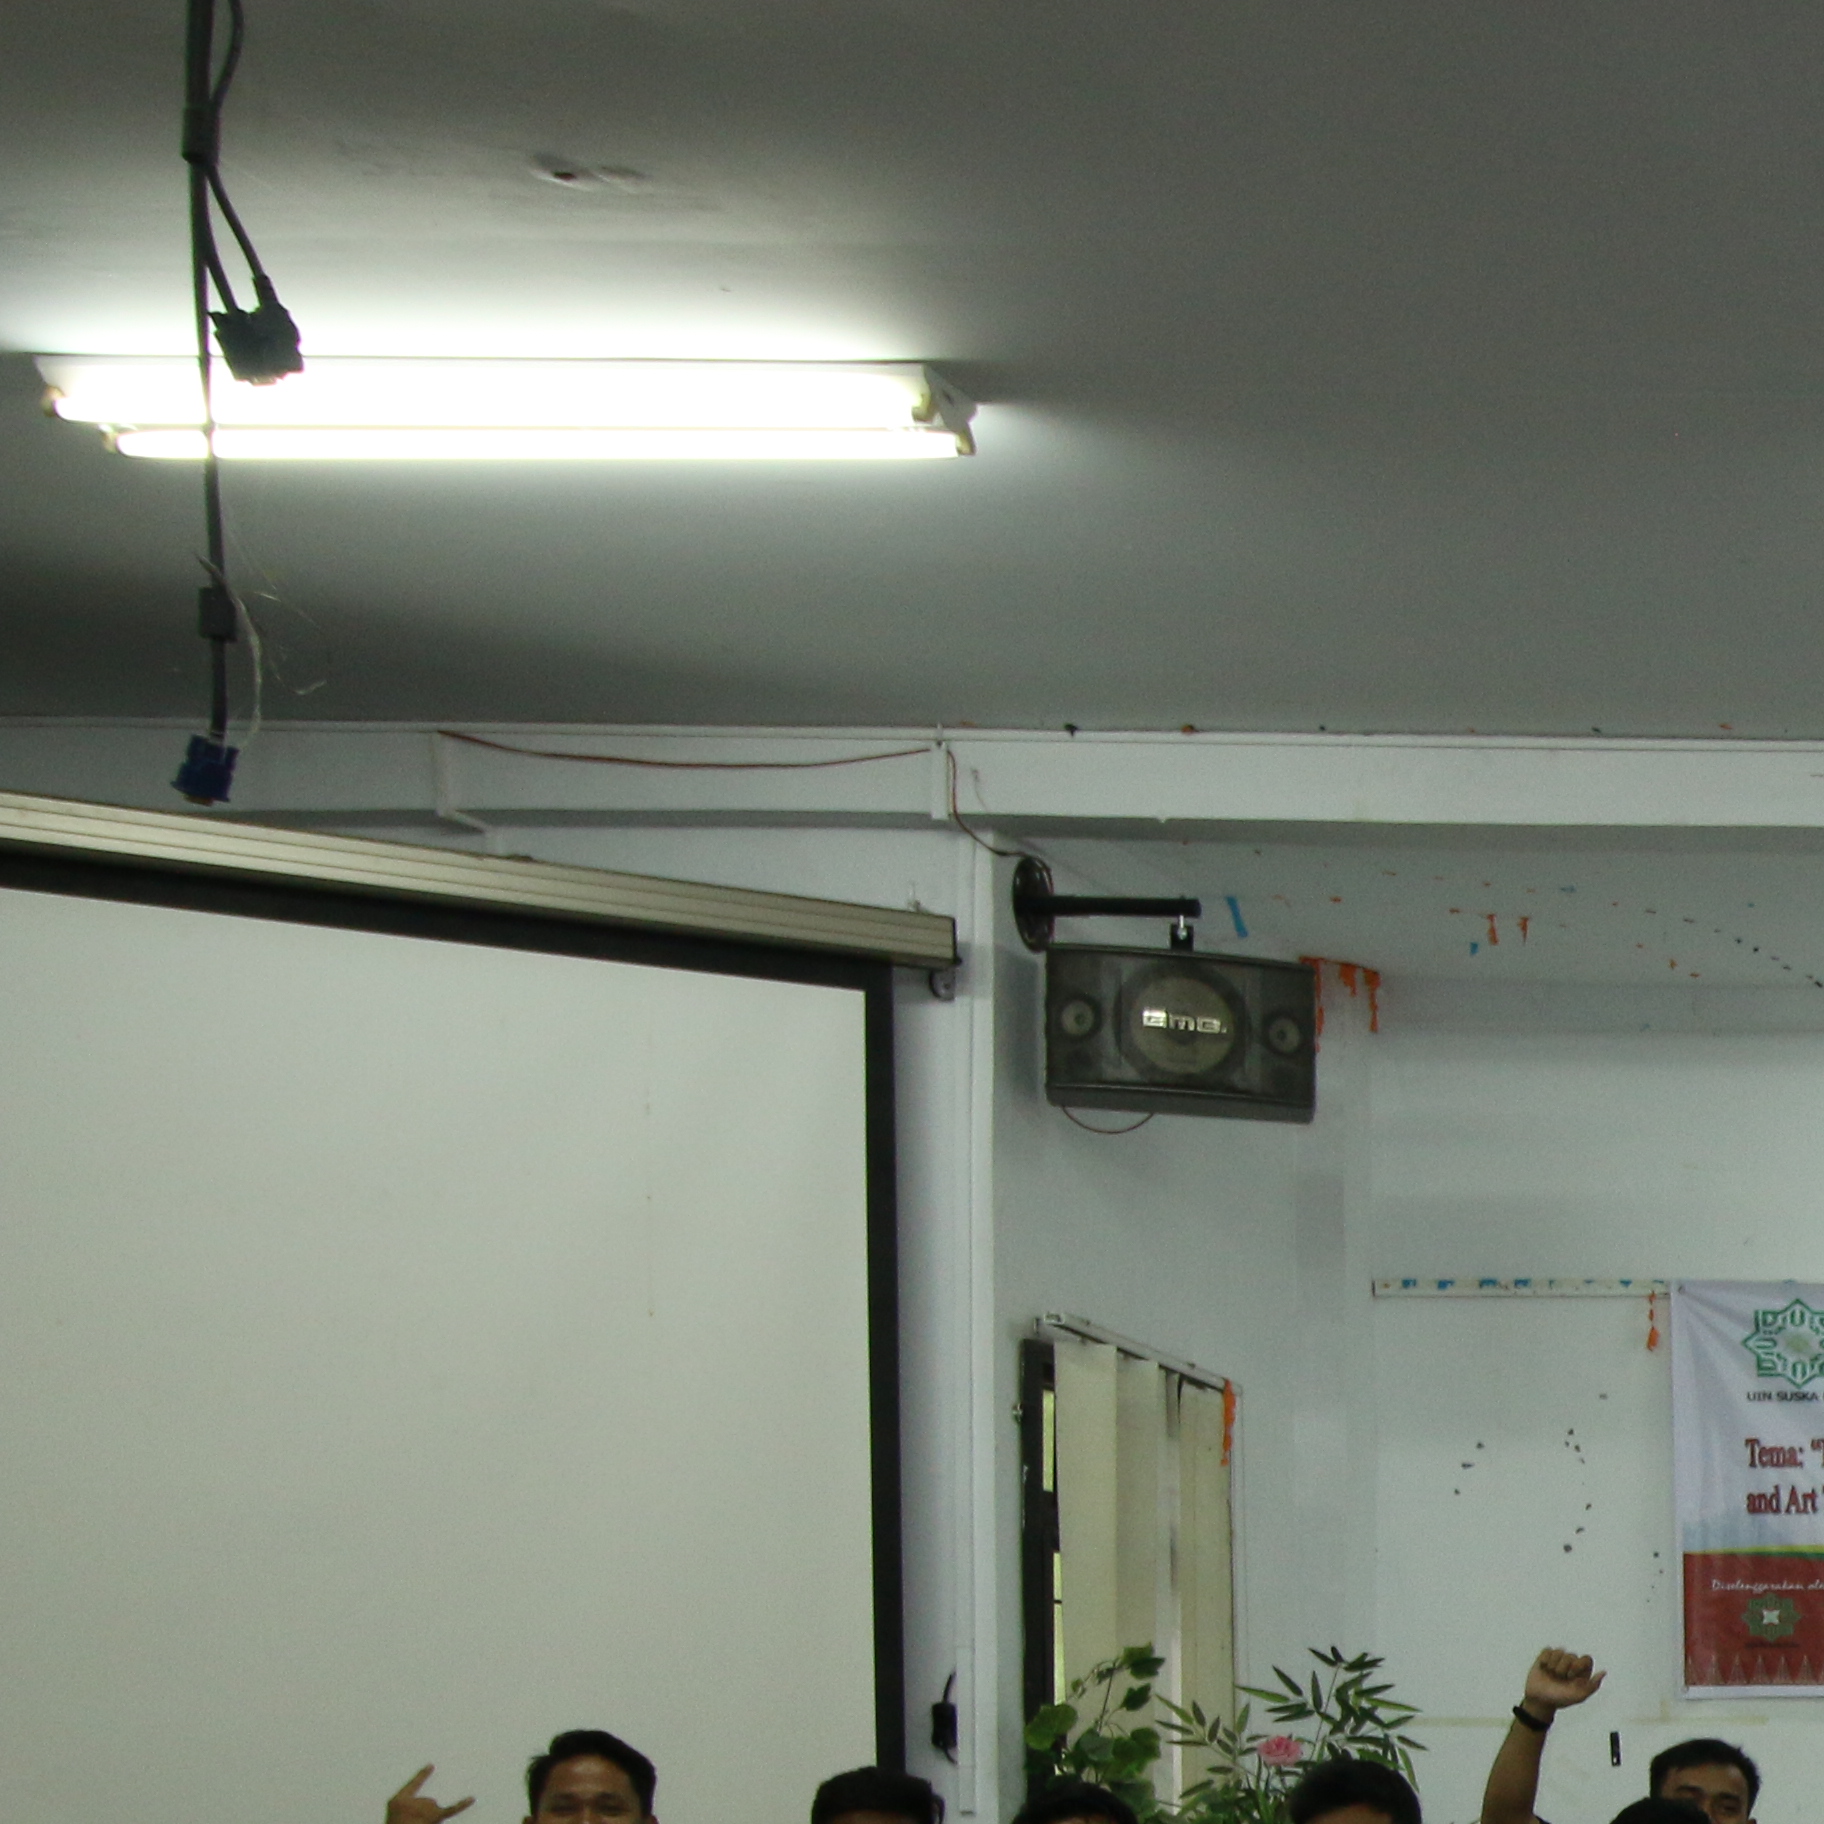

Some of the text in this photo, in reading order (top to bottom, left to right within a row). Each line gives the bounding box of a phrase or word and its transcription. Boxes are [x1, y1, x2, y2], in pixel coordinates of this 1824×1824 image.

[1746, 1391, 1772, 1402] UIN
[1776, 1391, 1818, 1402] SUSKA
[1745, 1437, 1805, 1470] Tema:
[1746, 1484, 1782, 1515] and
[1785, 1485, 1818, 1515] Art
[1711, 1579, 1805, 1595] Diselenggarakan
